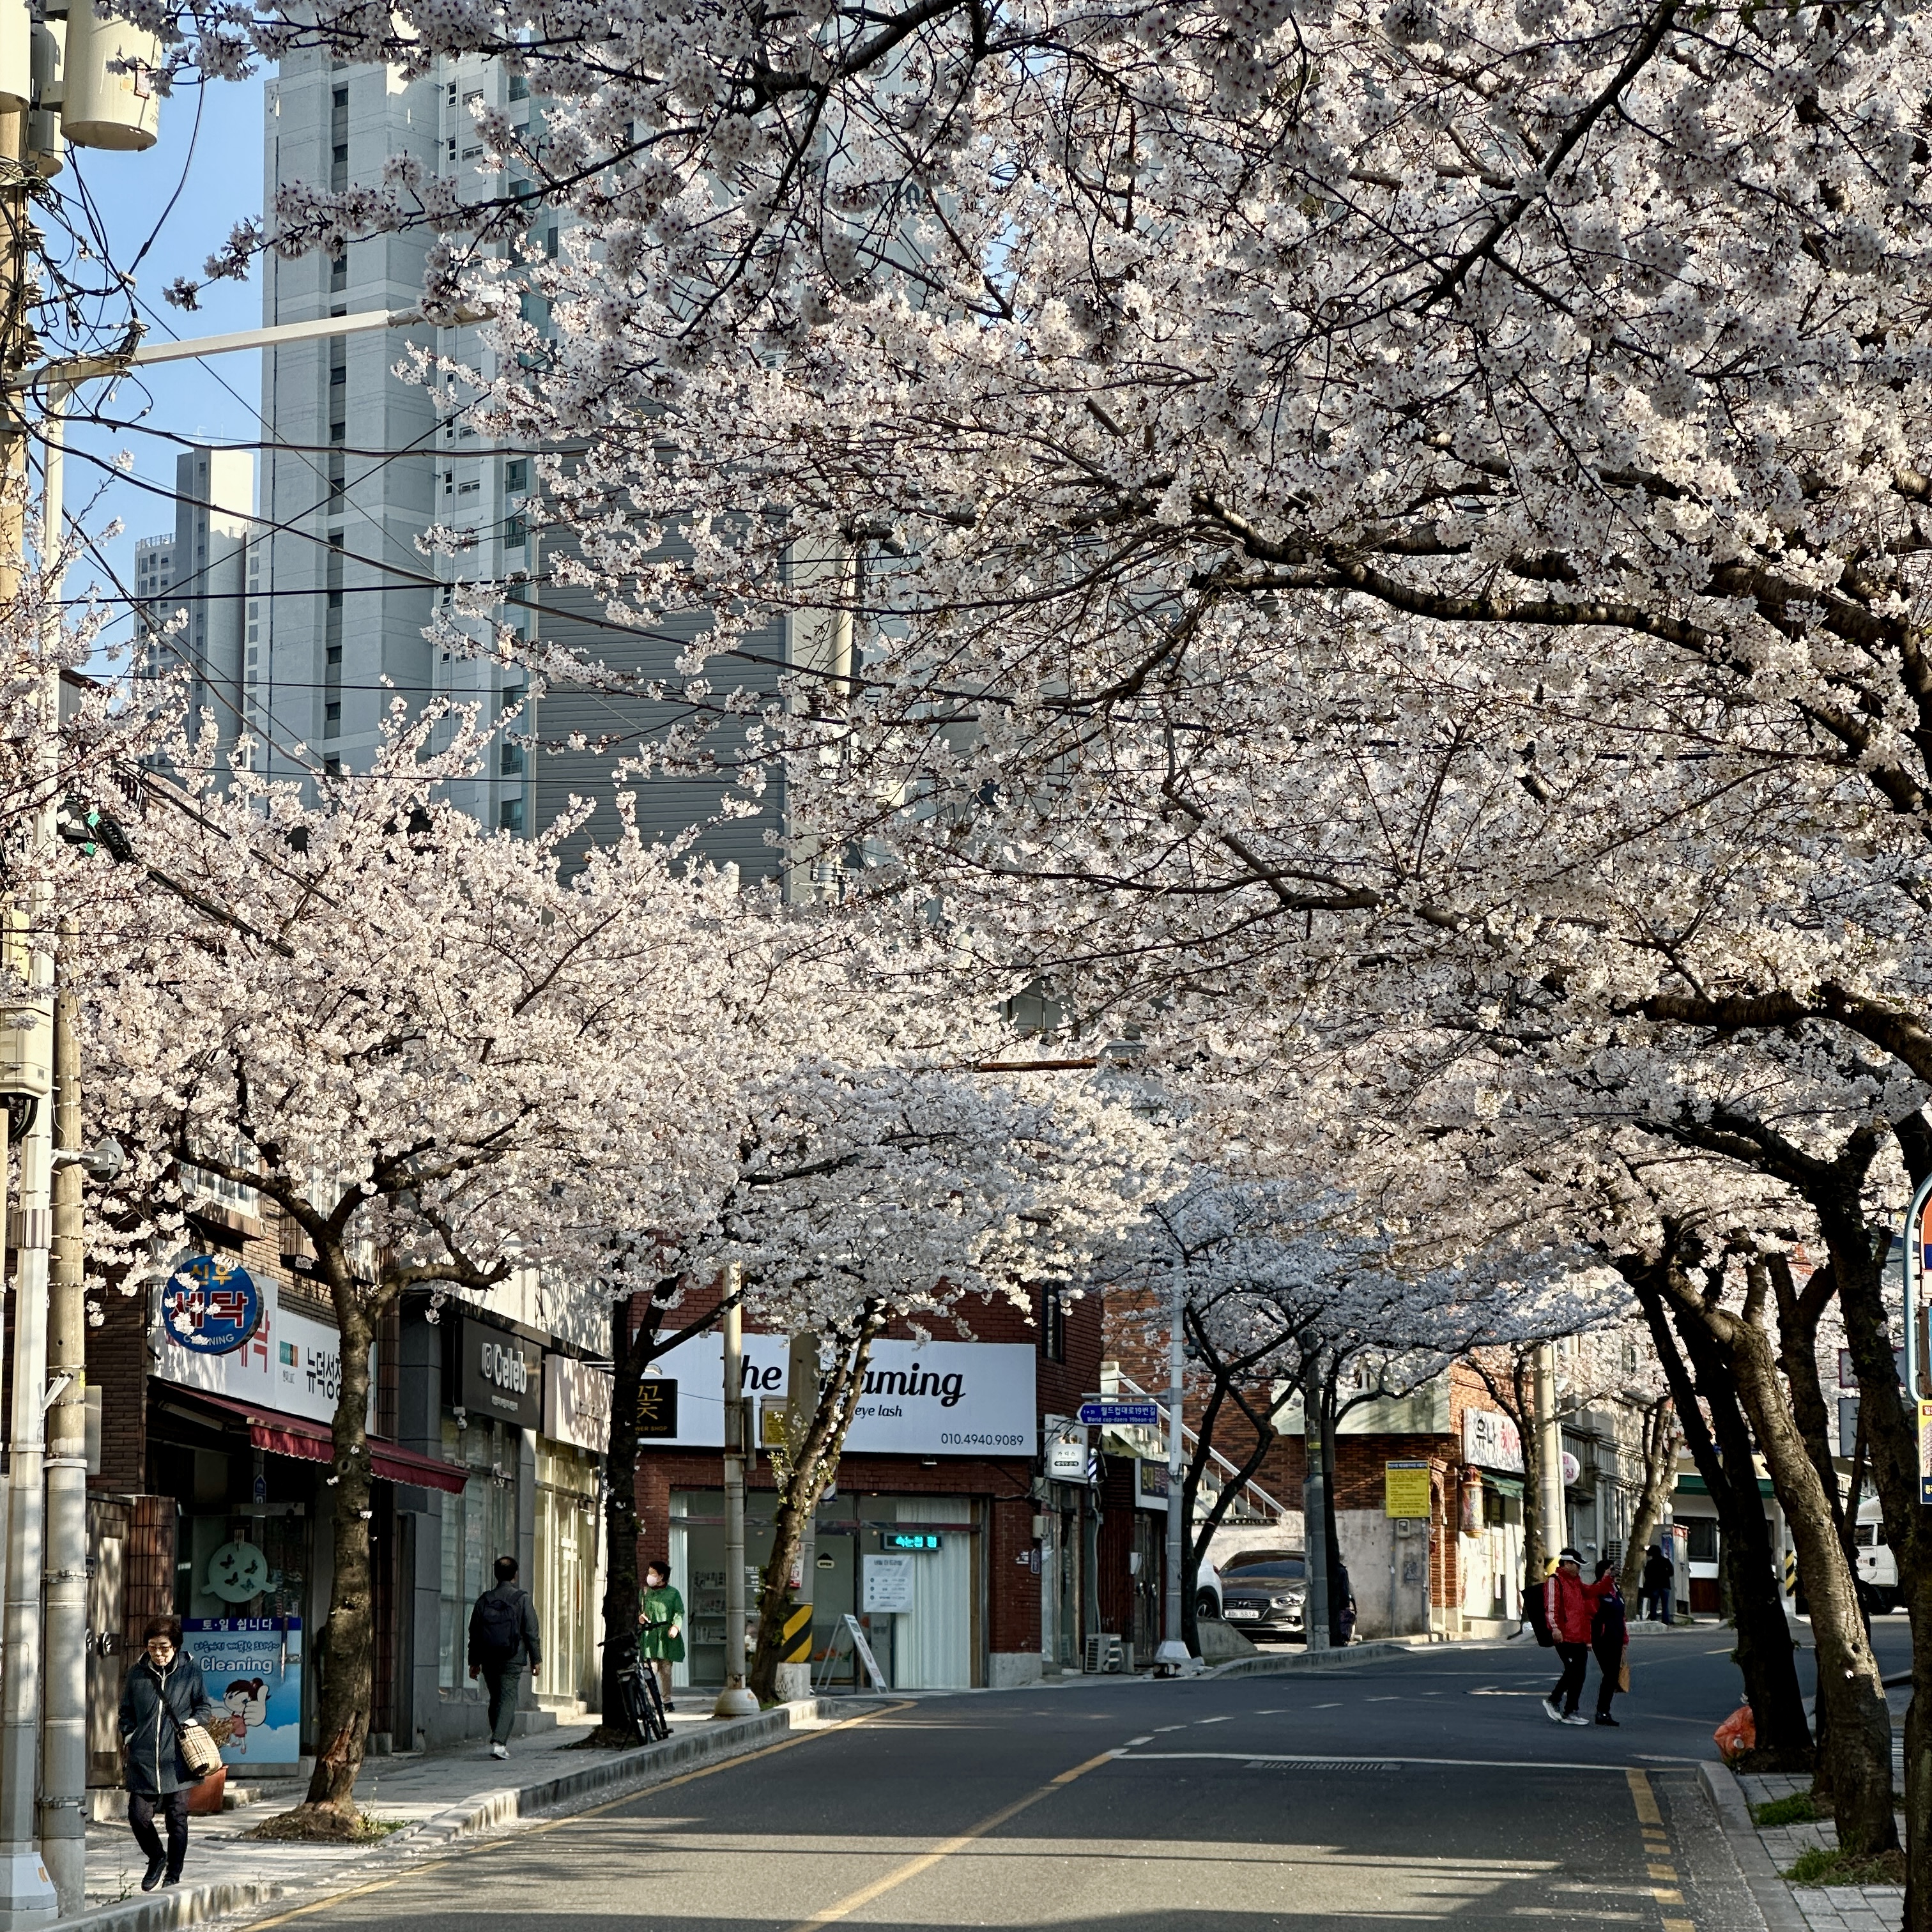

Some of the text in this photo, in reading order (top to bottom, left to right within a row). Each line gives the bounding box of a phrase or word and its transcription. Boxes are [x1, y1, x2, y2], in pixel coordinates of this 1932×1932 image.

[192, 1264, 233, 1285] 신우
[169, 1291, 249, 1328] 세탁
[183, 1334, 234, 1346] CNING
[493, 1344, 527, 1394] Celeb
[720, 1354, 782, 1390] he
[636, 1385, 663, 1420] 꽃
[1101, 1406, 1156, 1416] 월드컵대로19번길
[855, 1407, 875, 1419] eye
[878, 1404, 903, 1417] lash
[941, 1432, 1024, 1446] 010.4940.9089
[202, 1618, 273, 1631] 토·일 쉽니다
[201, 1657, 273, 1674] Cleaning
